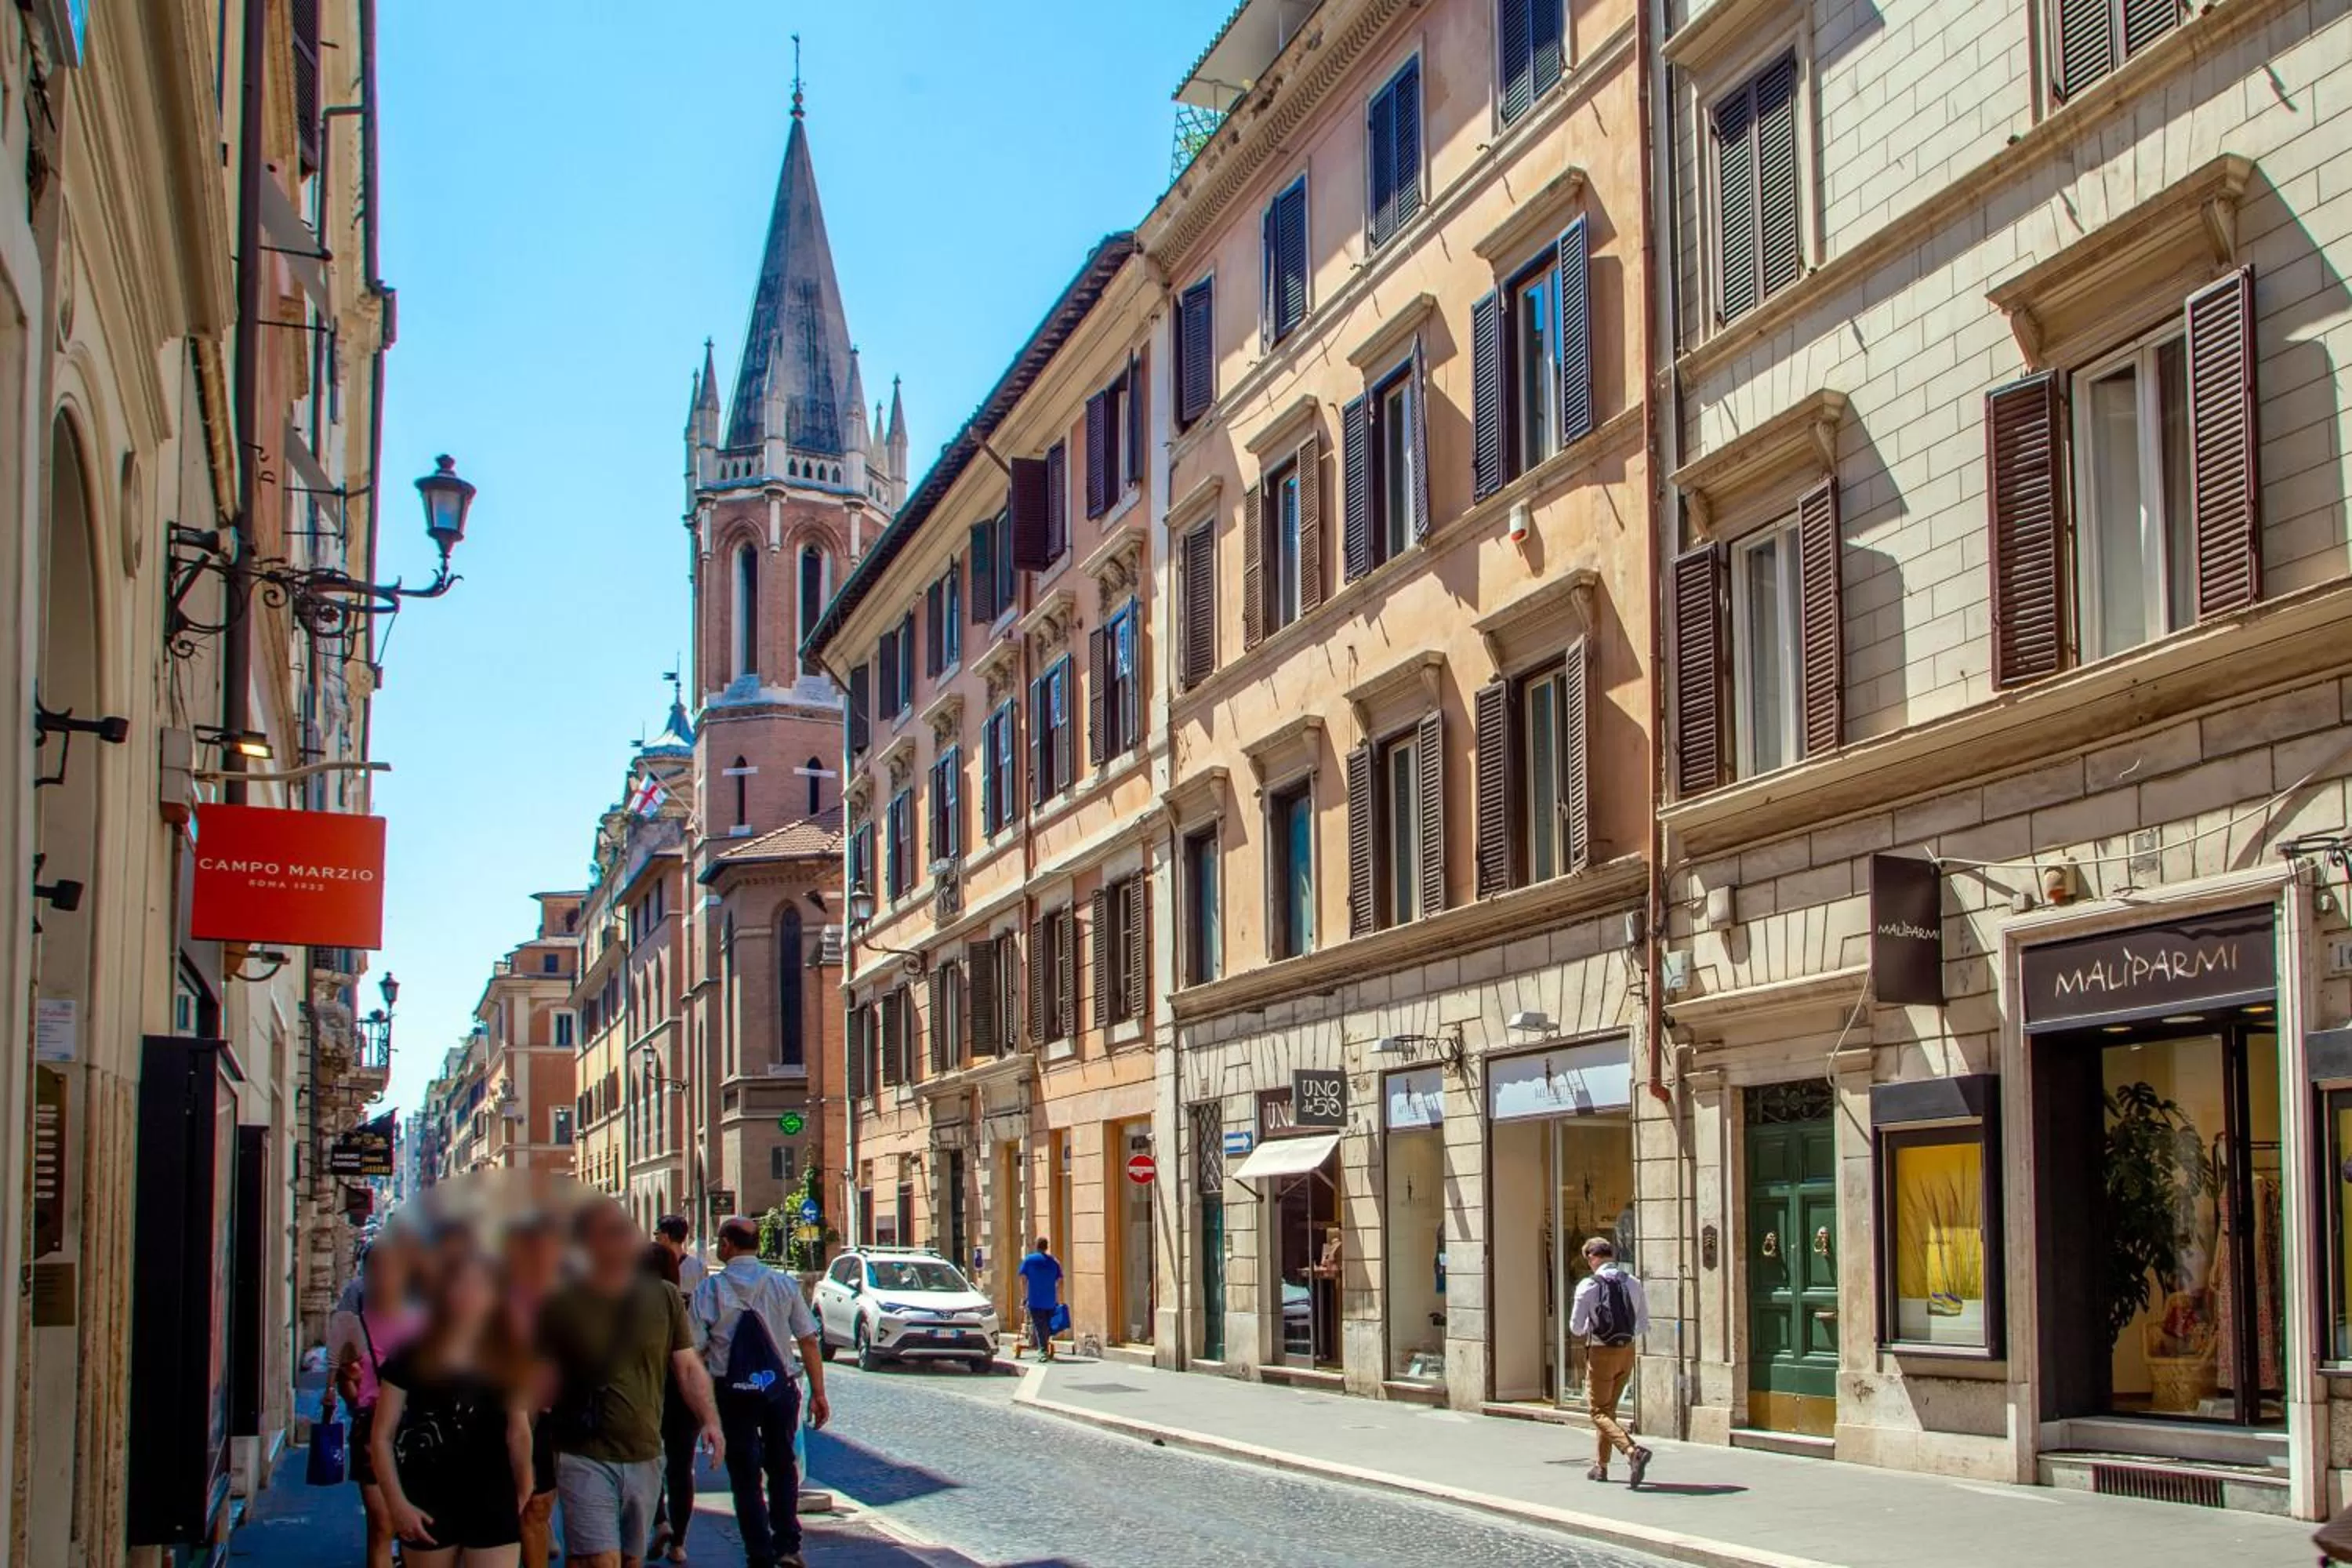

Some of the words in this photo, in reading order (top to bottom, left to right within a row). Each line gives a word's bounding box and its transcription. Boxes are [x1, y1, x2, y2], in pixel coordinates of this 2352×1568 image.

[199, 858, 280, 875] CAMPO
[289, 865, 374, 881] MARZIO
[248, 879, 287, 889] ROMA
[1302, 1080, 1341, 1097] UNO
